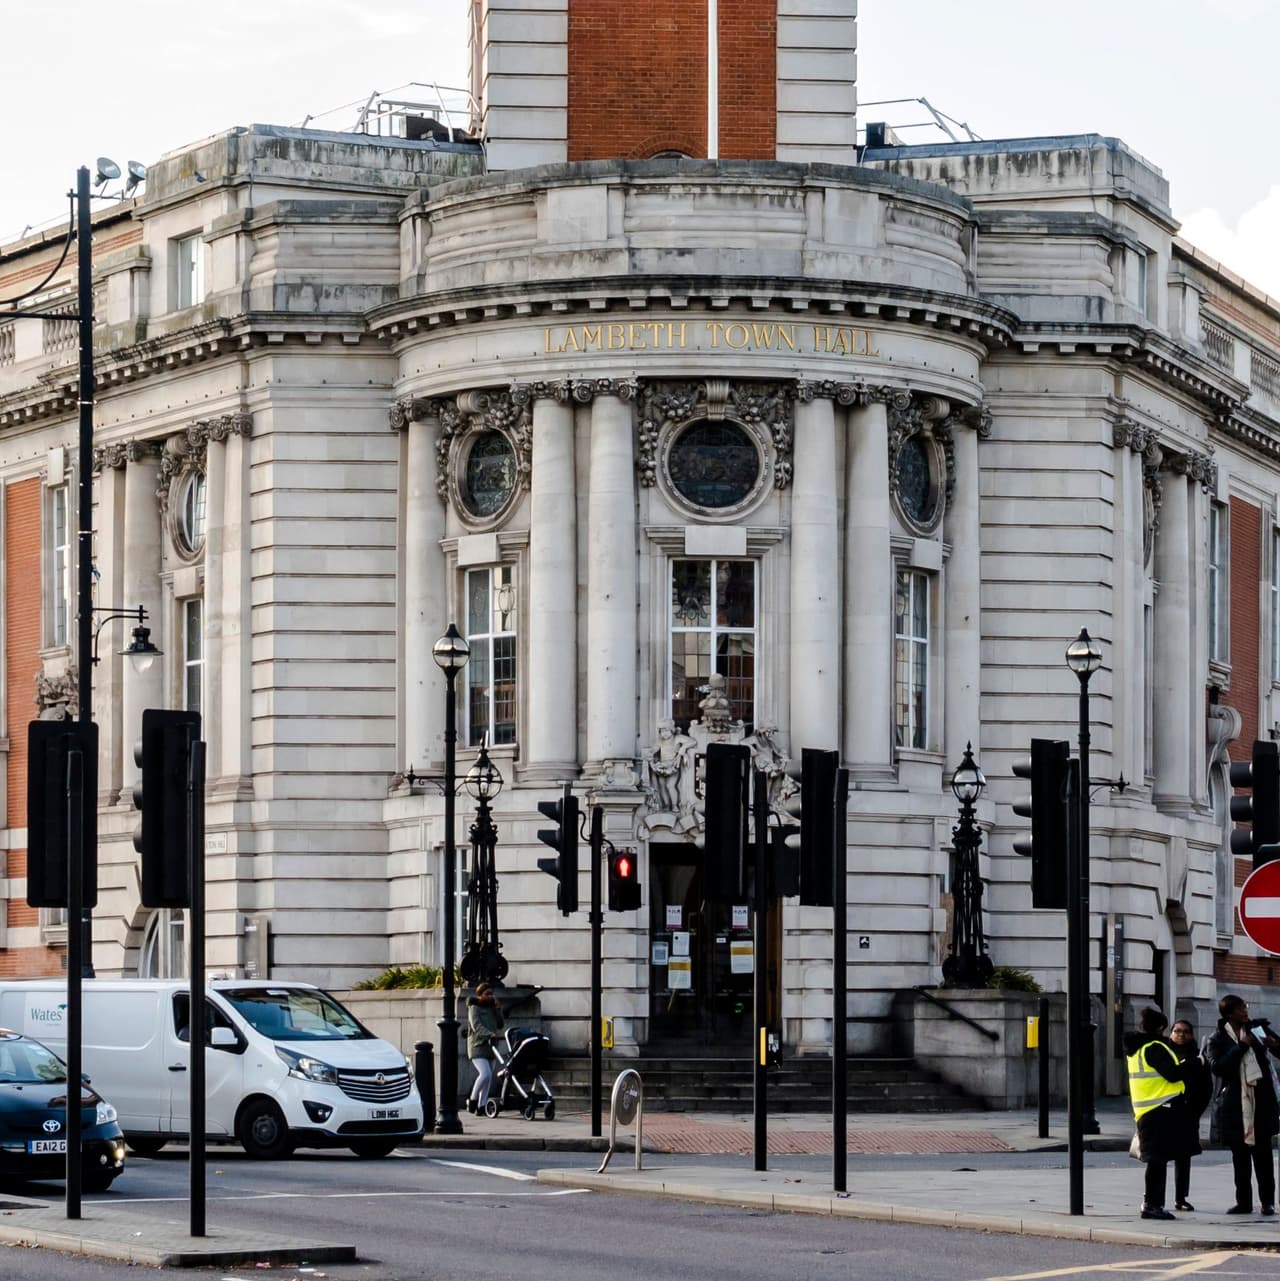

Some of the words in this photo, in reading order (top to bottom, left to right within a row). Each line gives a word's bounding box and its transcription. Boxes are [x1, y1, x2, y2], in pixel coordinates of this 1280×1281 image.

[544, 323, 686, 353] LAMBETH
[706, 322, 796, 350] TOWN
[813, 327, 880, 357] HALL
[31, 1008, 62, 1021] Wates
[36, 1141, 57, 1151] EA12
